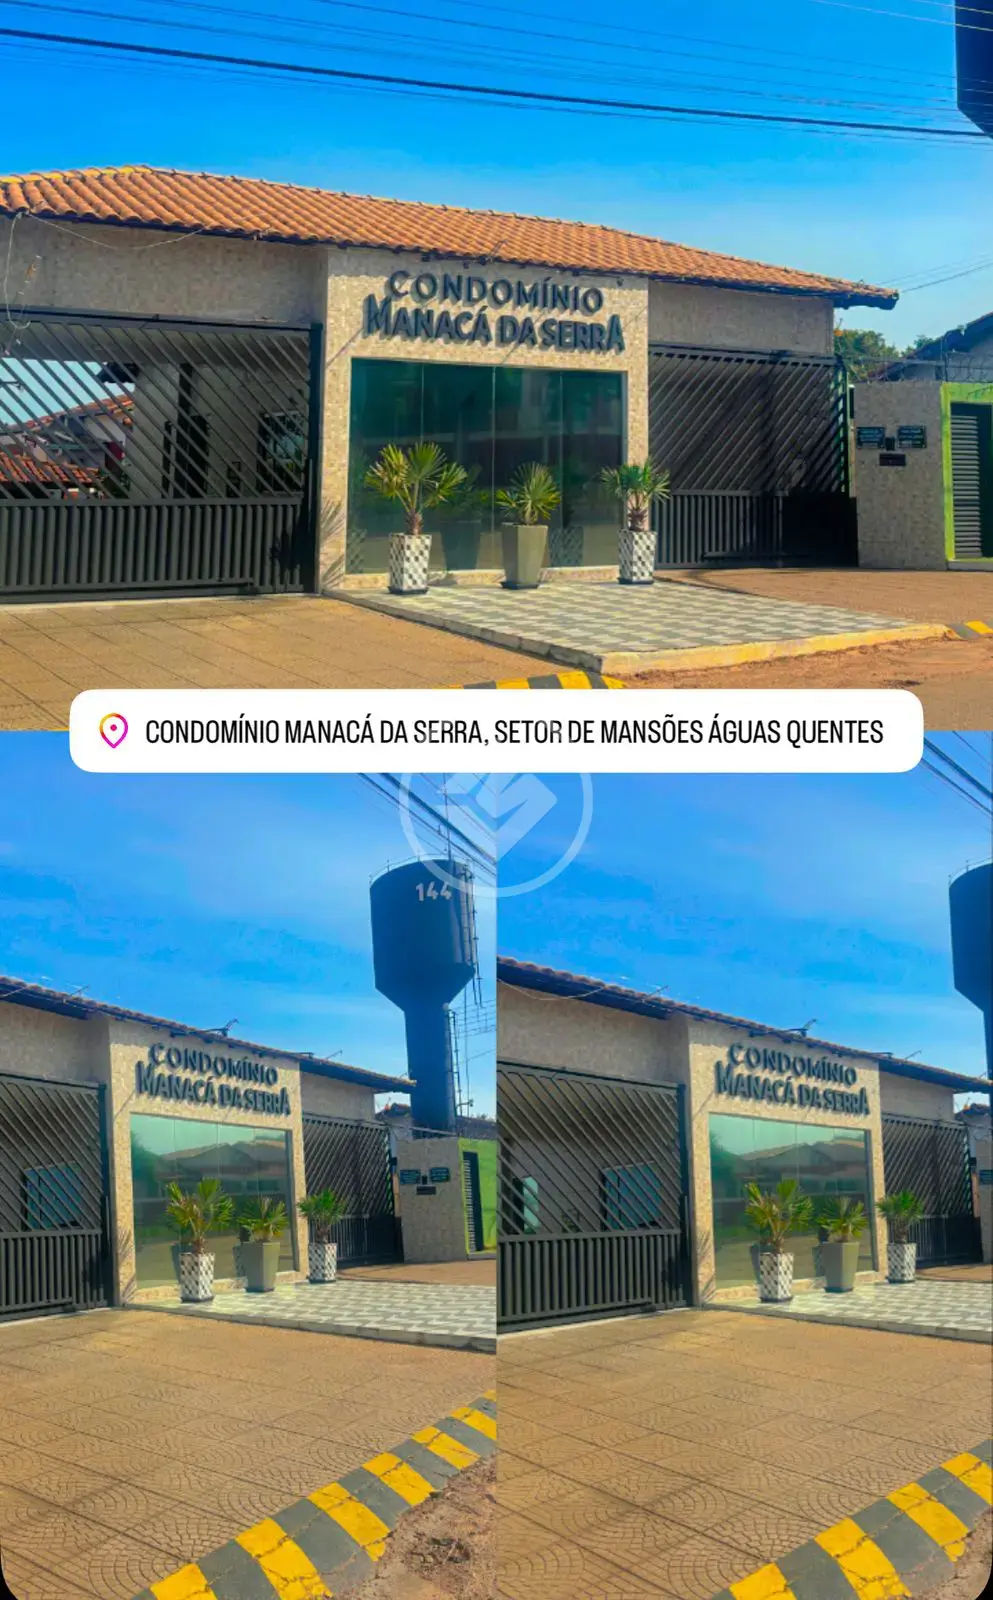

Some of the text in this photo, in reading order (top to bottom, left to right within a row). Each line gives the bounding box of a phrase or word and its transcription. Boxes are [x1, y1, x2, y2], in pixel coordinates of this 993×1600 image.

[387, 270, 604, 314] CONDOMÍNIO
[362, 293, 626, 352] MANACÁ DA SERRA
[416, 882, 452, 902] 144
[135, 1060, 217, 1105] MANACÁ
[149, 1042, 278, 1086] CONDOMÍNIO
[715, 1060, 795, 1105] MANACÁ
[729, 1042, 857, 1087] CONDOMÍNIO
